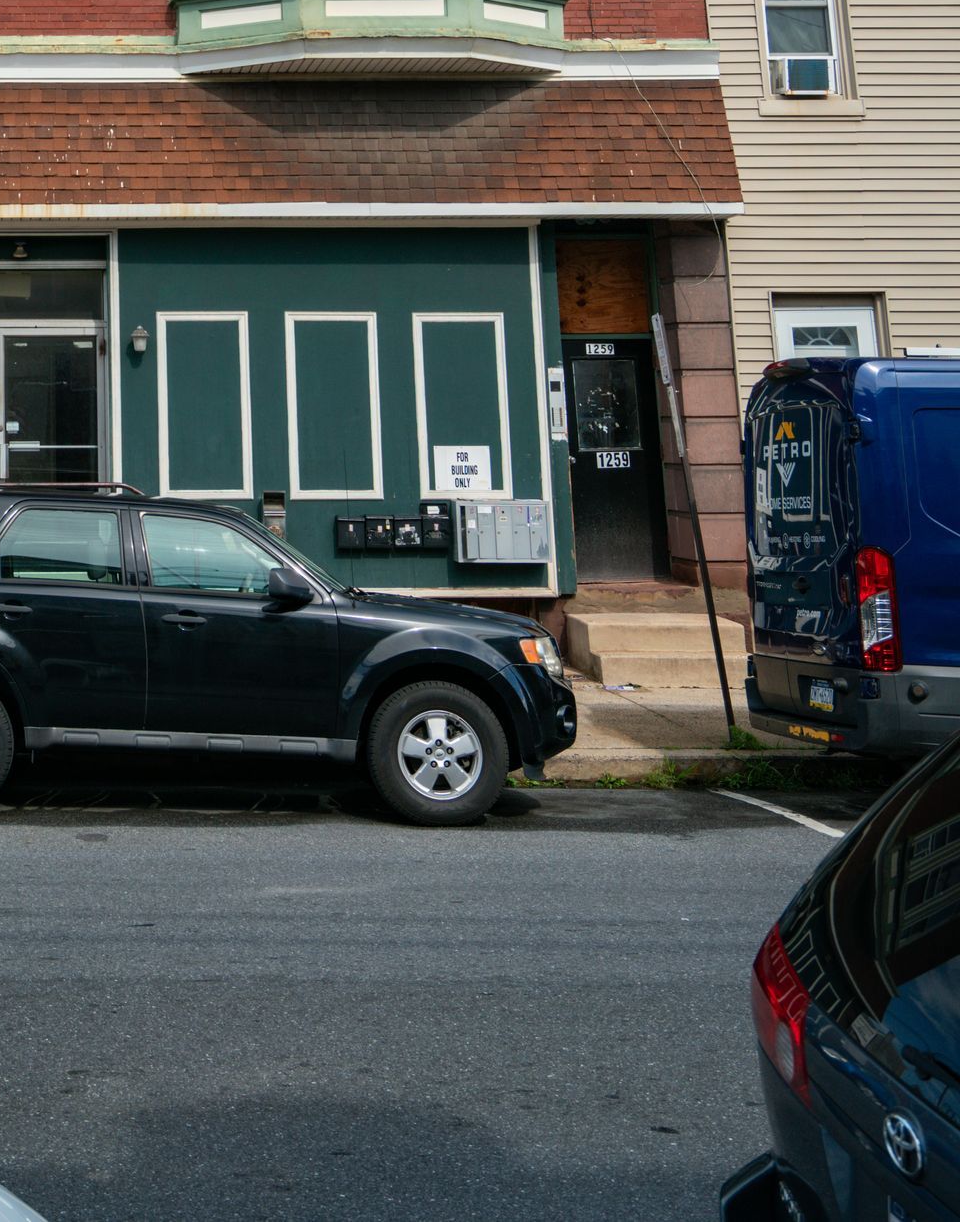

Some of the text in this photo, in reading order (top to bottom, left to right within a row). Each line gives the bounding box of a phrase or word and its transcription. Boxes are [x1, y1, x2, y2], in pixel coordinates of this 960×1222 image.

[587, 344, 613, 354] 1259
[763, 440, 811, 462] PETRO
[456, 452, 469, 462] FOR
[598, 453, 630, 468] 1259
[451, 465, 478, 475] BUILDING
[454, 478, 471, 488] ONLY
[783, 495, 811, 510] SERVICES
